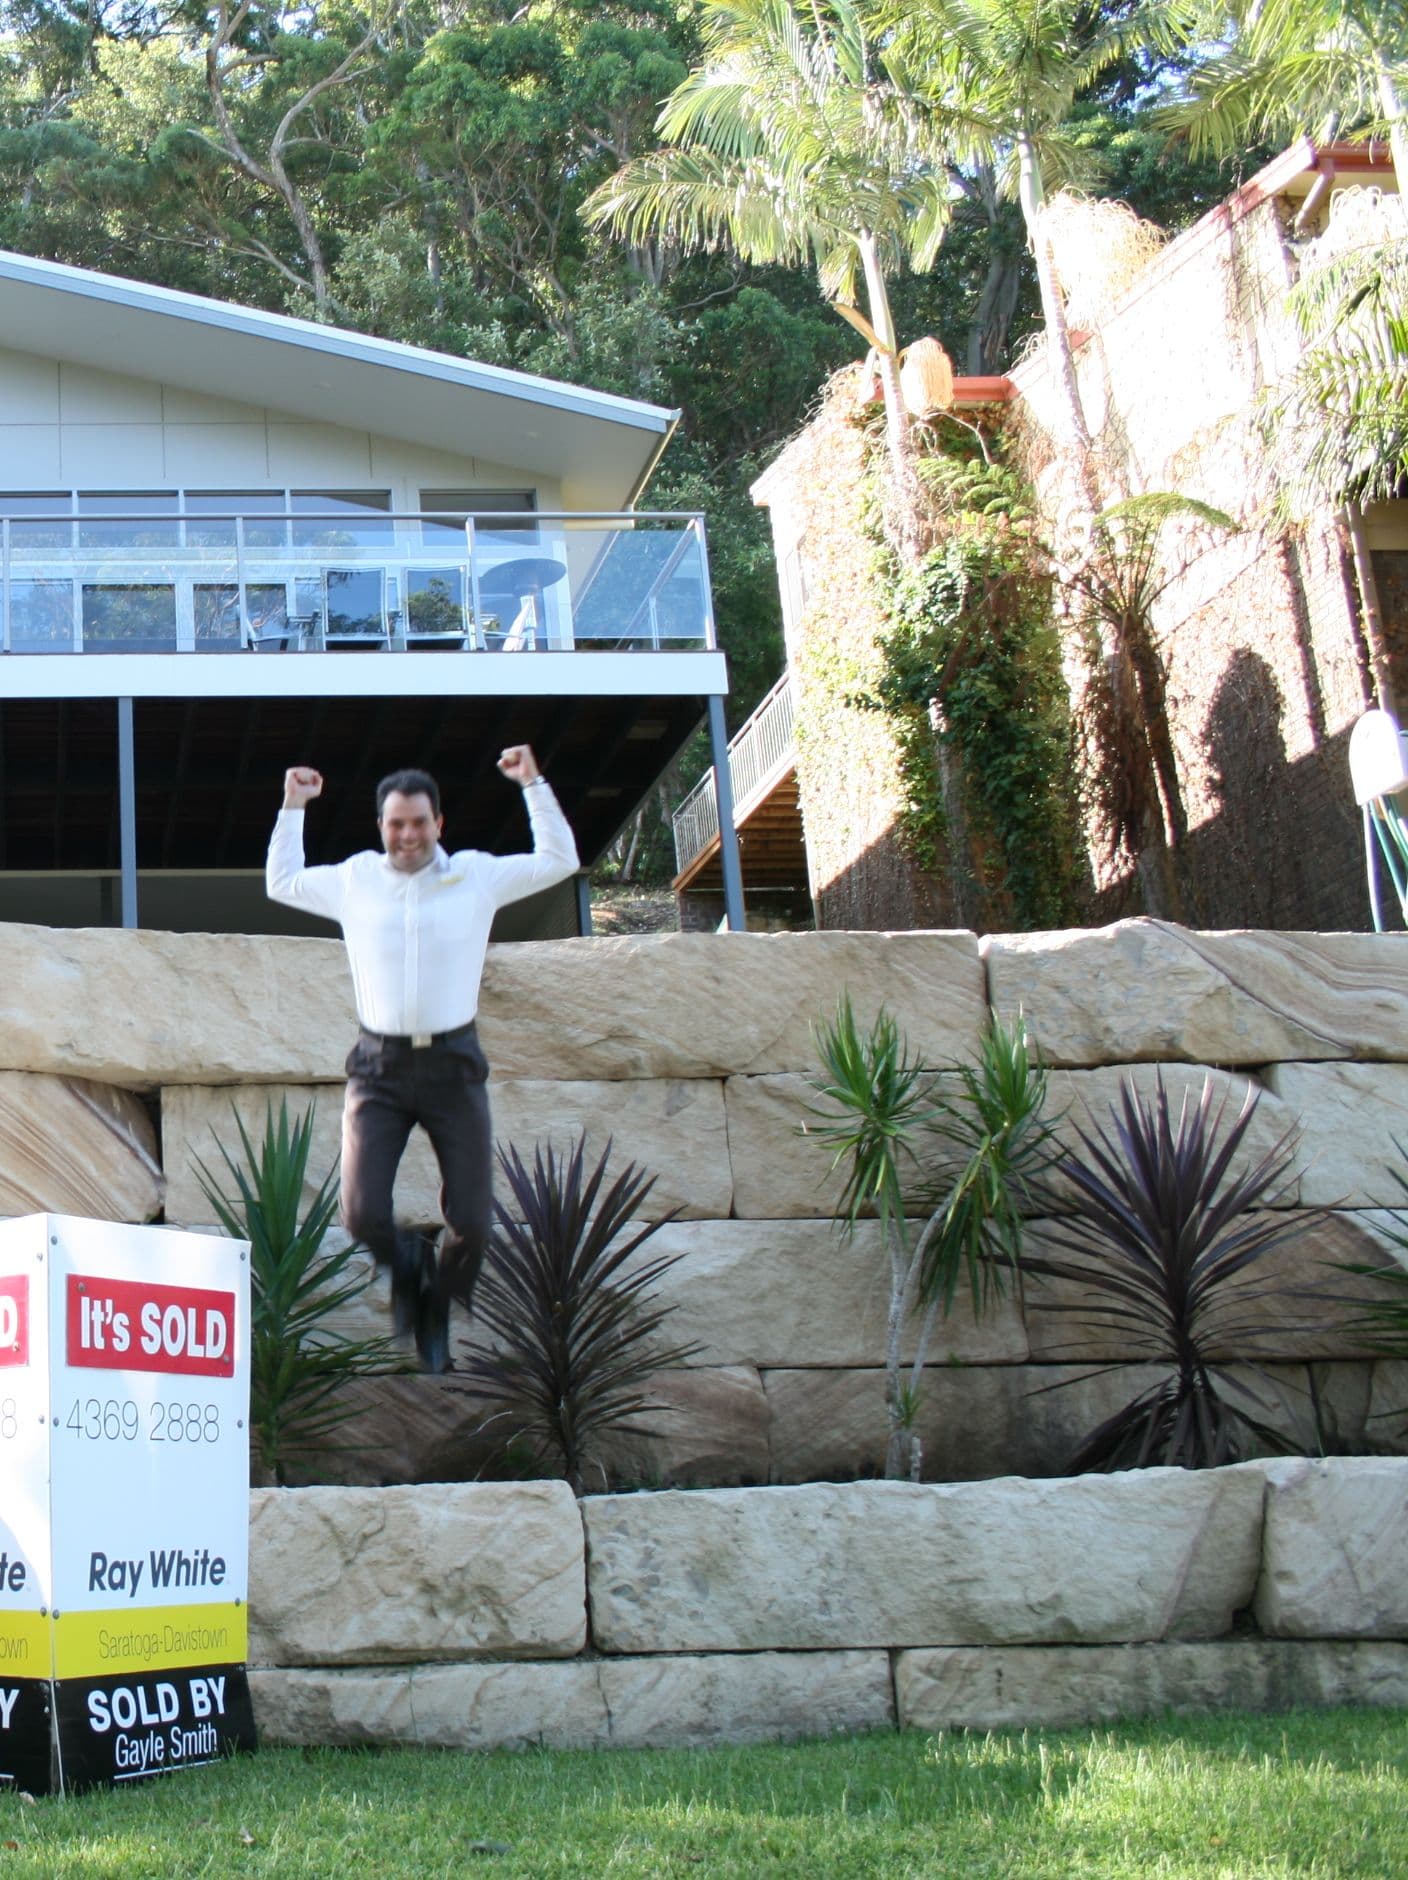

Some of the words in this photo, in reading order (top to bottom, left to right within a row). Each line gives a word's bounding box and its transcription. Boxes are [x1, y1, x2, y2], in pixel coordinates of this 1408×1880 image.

[80, 1296, 130, 1351] It's
[140, 1302, 227, 1359] SOLD
[66, 1398, 139, 1441] 4369
[149, 1401, 220, 1443] 2888
[89, 1552, 144, 1597] Ray
[150, 1549, 226, 1588] White
[99, 1624, 228, 1662] Saratoga-Davistown
[87, 1682, 180, 1732] SOLD
[189, 1676, 226, 1716] BY
[115, 1729, 165, 1771] Gayle
[170, 1722, 217, 1759] Smith
